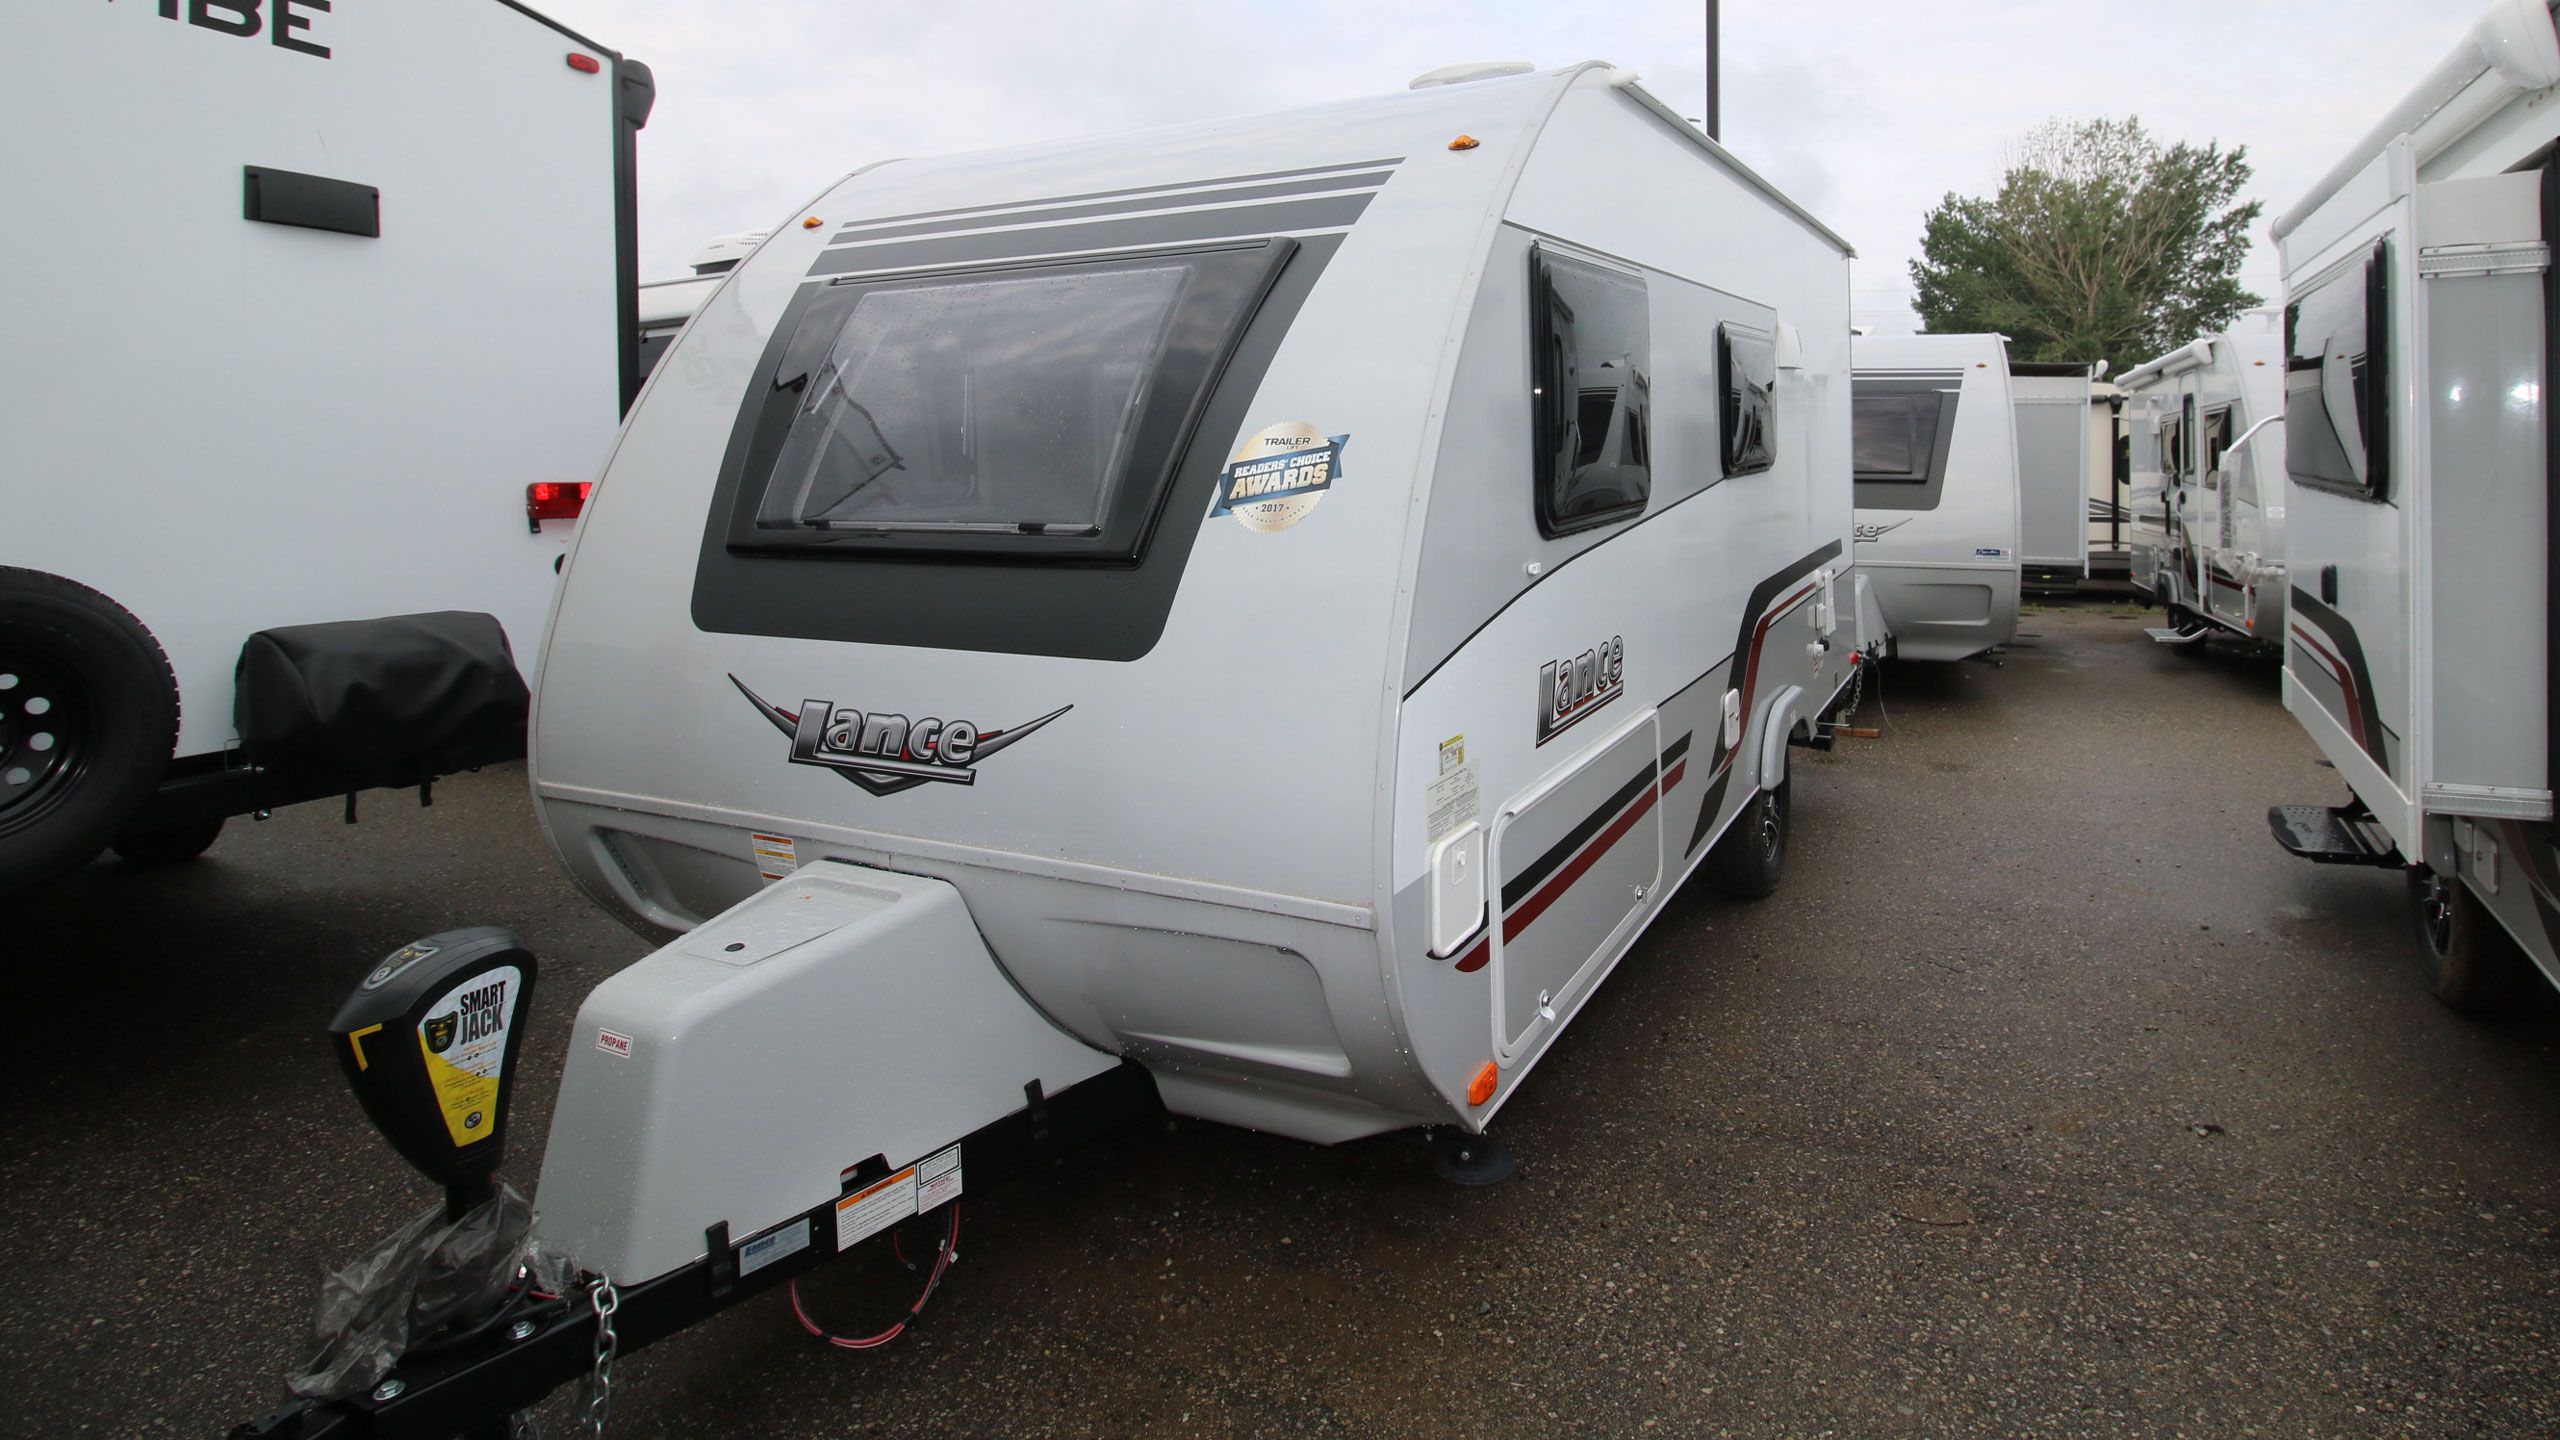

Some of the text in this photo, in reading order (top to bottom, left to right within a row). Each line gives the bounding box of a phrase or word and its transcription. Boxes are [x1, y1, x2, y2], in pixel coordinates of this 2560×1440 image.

[1264, 437, 1311, 446] TRAILER
[1289, 450, 1331, 468] CHOICE
[1228, 463, 1328, 500] AWARDS
[1261, 503, 1284, 513] 2017
[1536, 635, 1624, 749] Lance
[789, 699, 979, 787] Lance
[460, 980, 506, 1016] SMART
[460, 1002, 504, 1045] JACK
[601, 1034, 628, 1051] PROPANE
